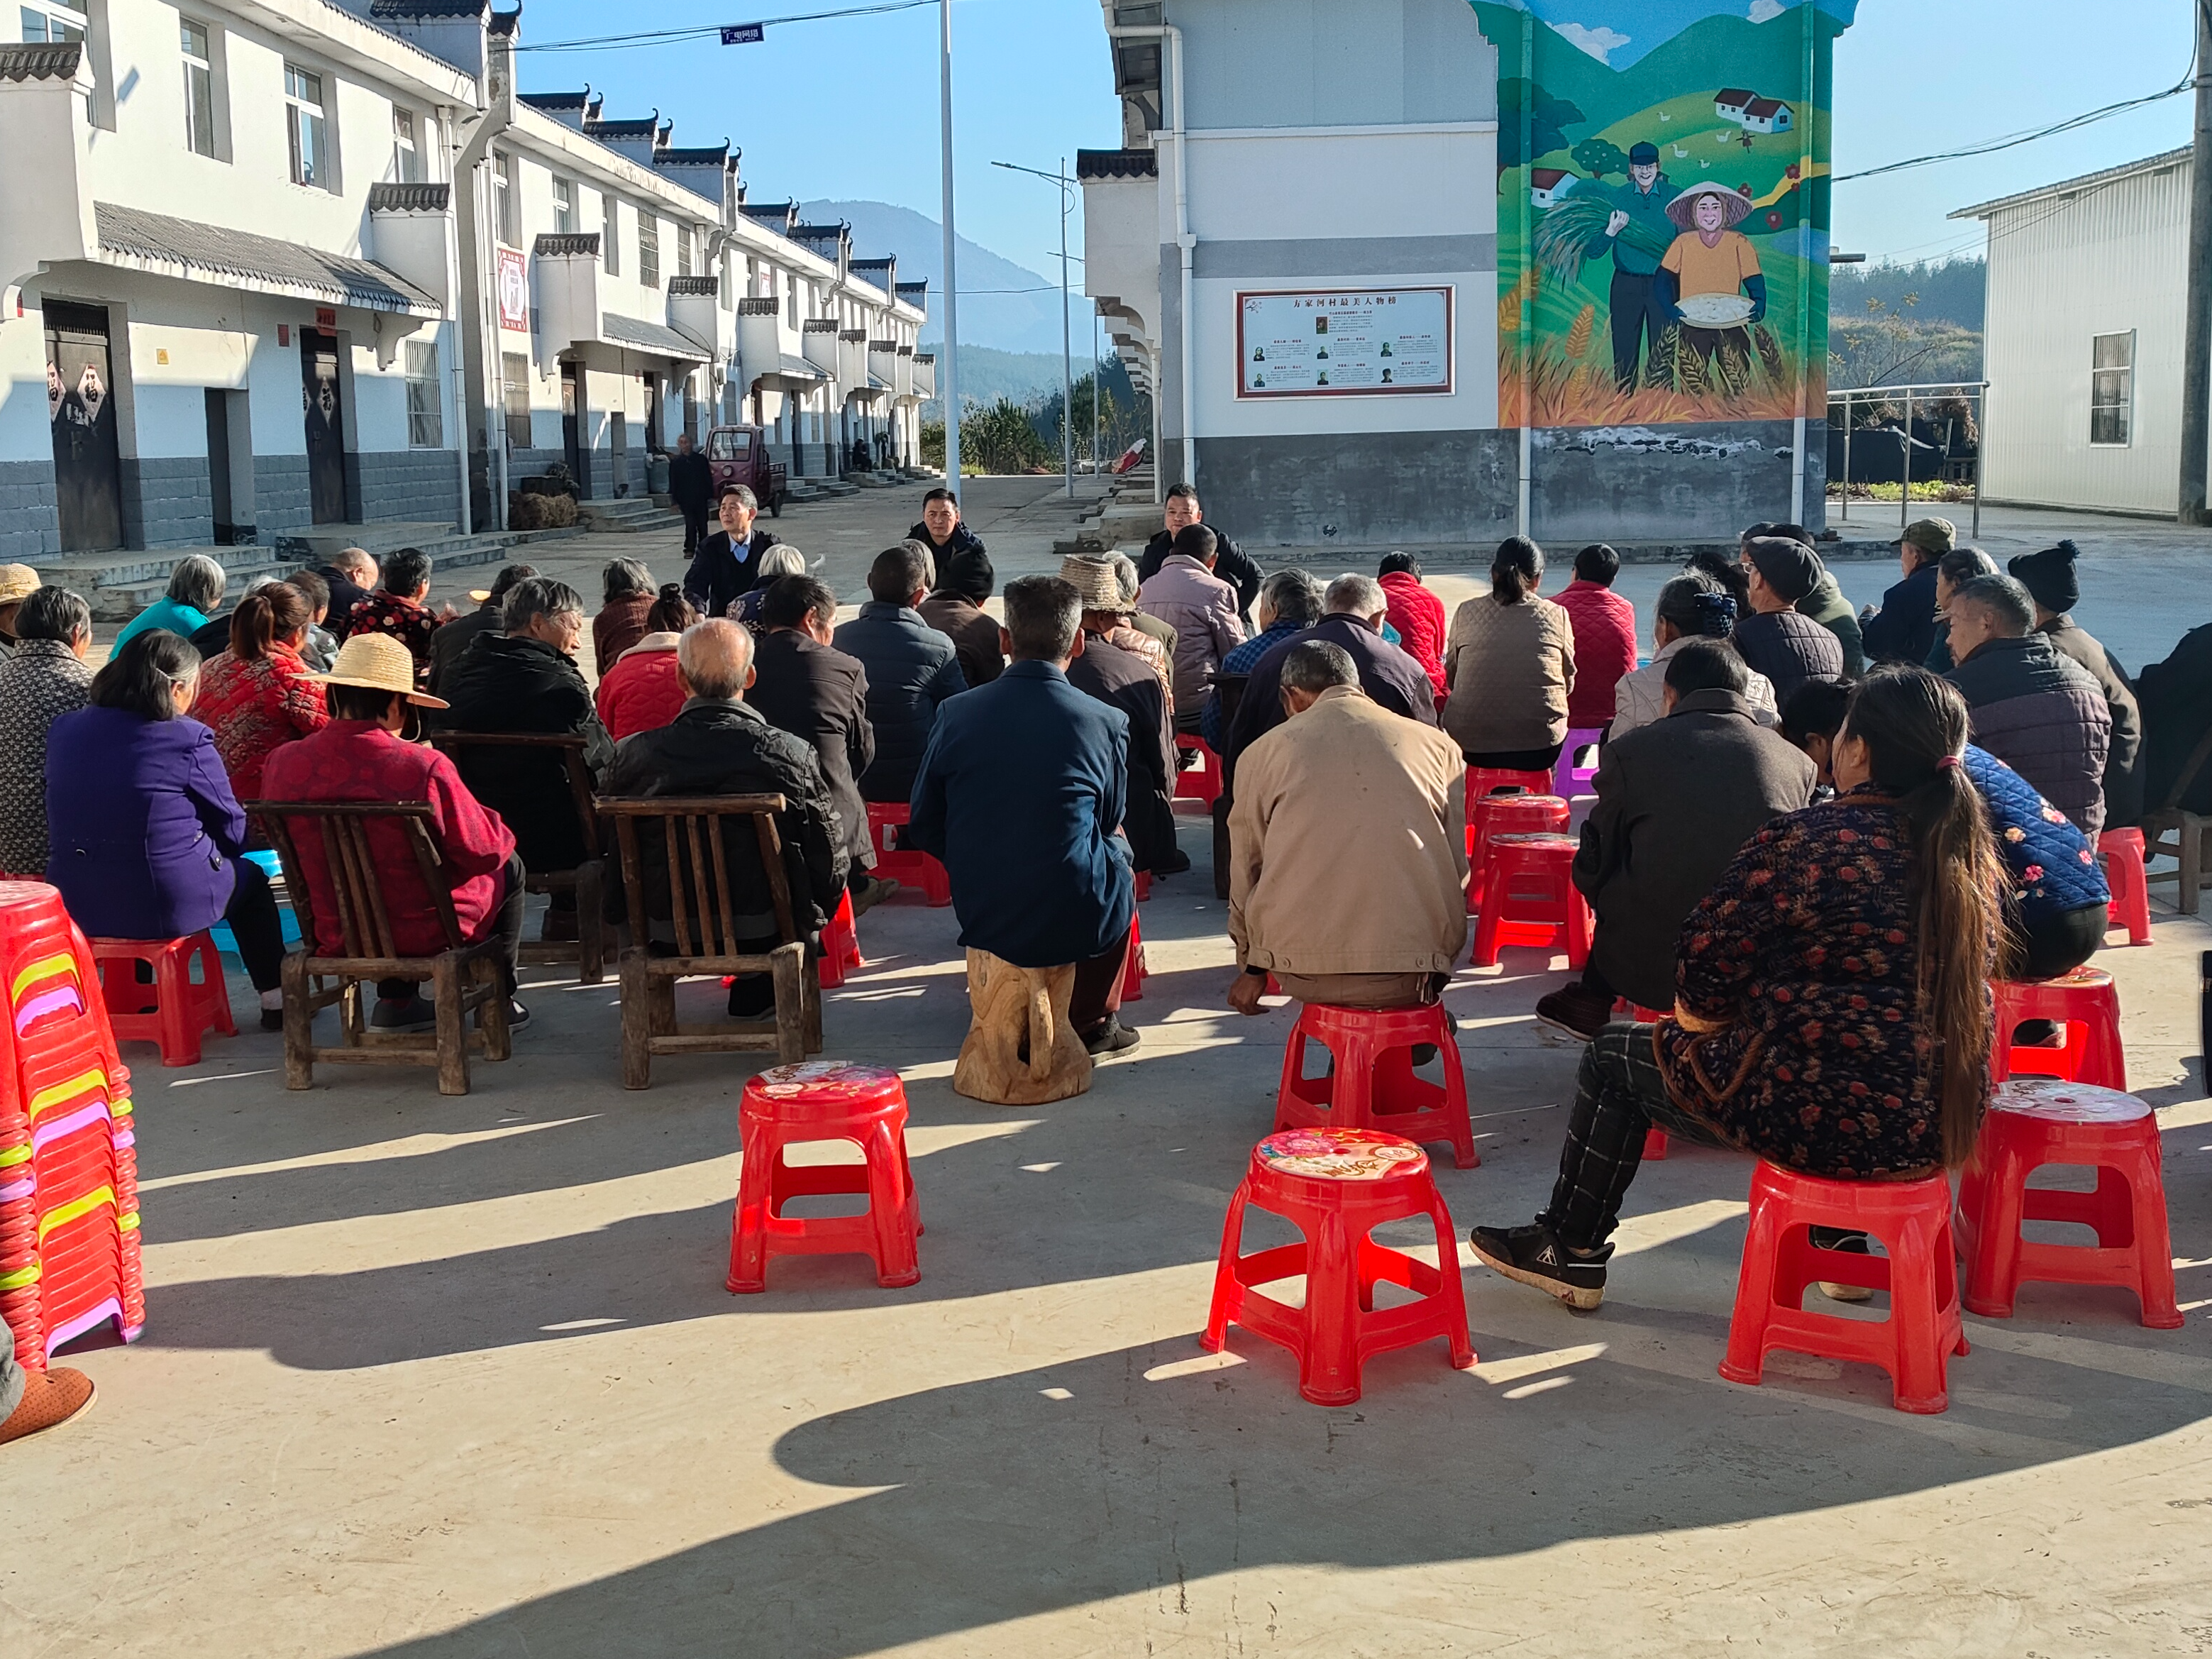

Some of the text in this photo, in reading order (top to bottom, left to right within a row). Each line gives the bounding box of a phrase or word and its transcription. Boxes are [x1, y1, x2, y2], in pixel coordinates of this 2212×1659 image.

[726, 28, 758, 40] 广电网络
[1293, 296, 1397, 308] 方家河村最美人物榜
[84, 373, 98, 403] 福
